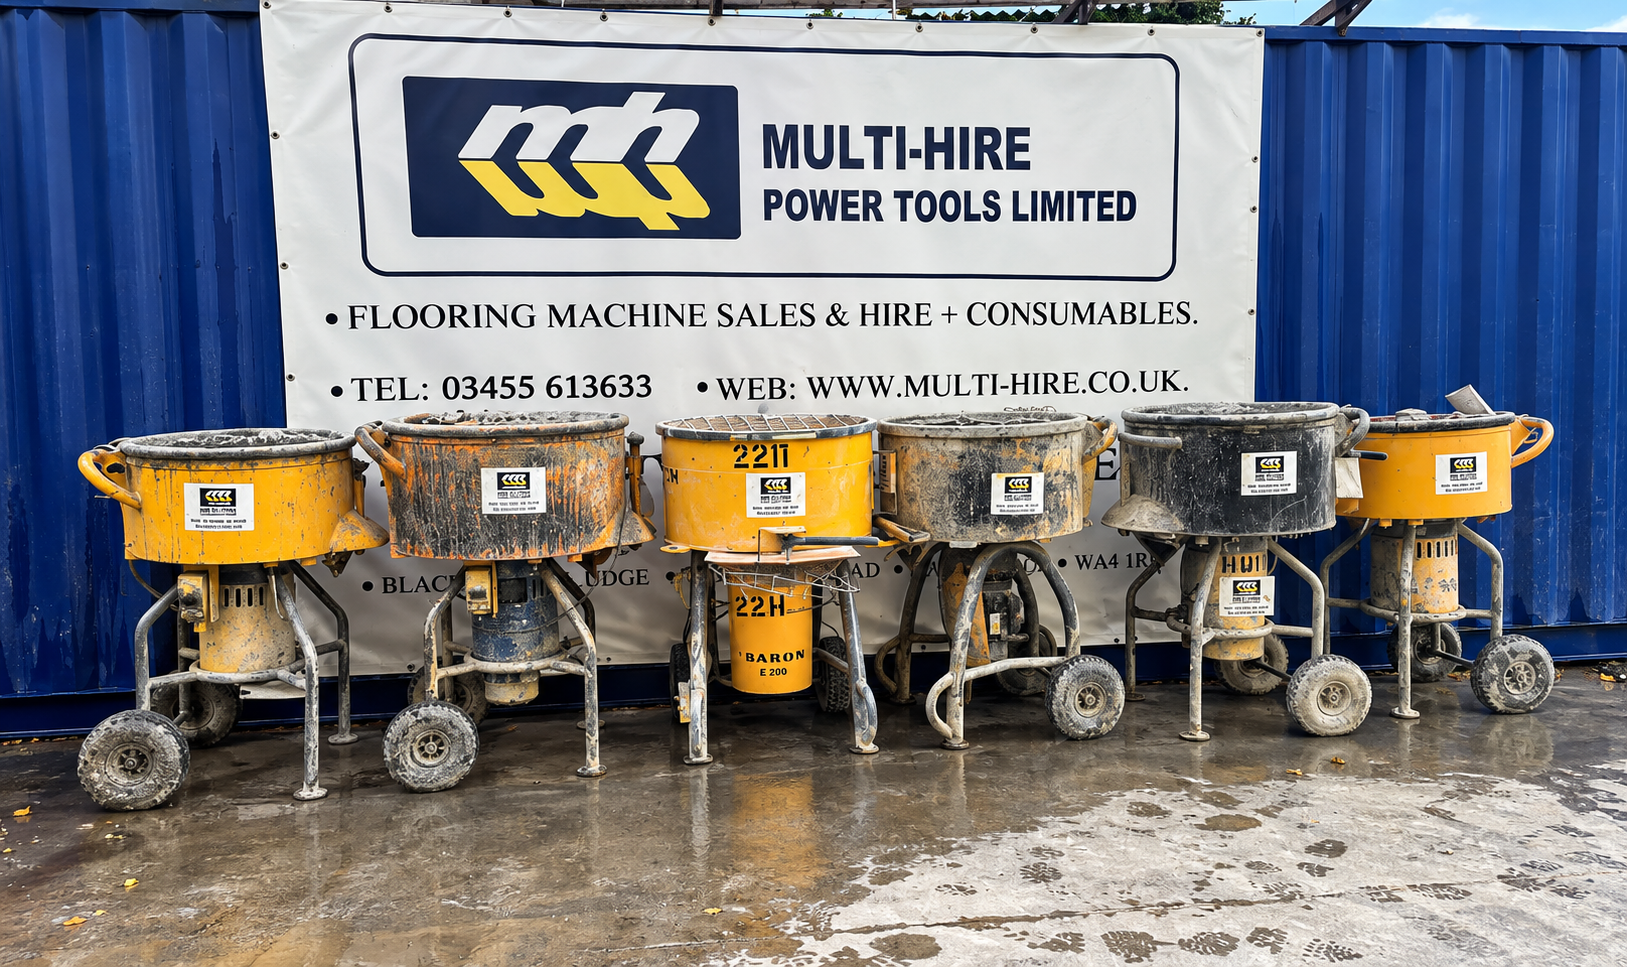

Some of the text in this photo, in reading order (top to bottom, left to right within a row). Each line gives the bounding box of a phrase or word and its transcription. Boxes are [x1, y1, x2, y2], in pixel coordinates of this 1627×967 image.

[763, 123, 1031, 170] MULTI-HIRE
[763, 189, 1137, 222] POWER TOOLS LIMITED
[348, 303, 536, 330] FLOORING
[547, 303, 708, 328] MACHINE
[717, 302, 816, 327] SALES
[825, 302, 850, 327] &
[860, 302, 933, 327] HIRE
[966, 300, 1198, 327] CONSUMABLES.
[350, 374, 652, 402] TEL: 03455 613633
[716, 369, 1189, 401] WEB: WWW.MULTI-HIRE.CO.UK.
[1074, 553, 1119, 571] WA4
[381, 575, 456, 594] BLAC
[745, 650, 805, 663] BARON
[760, 667, 788, 677] E 200
